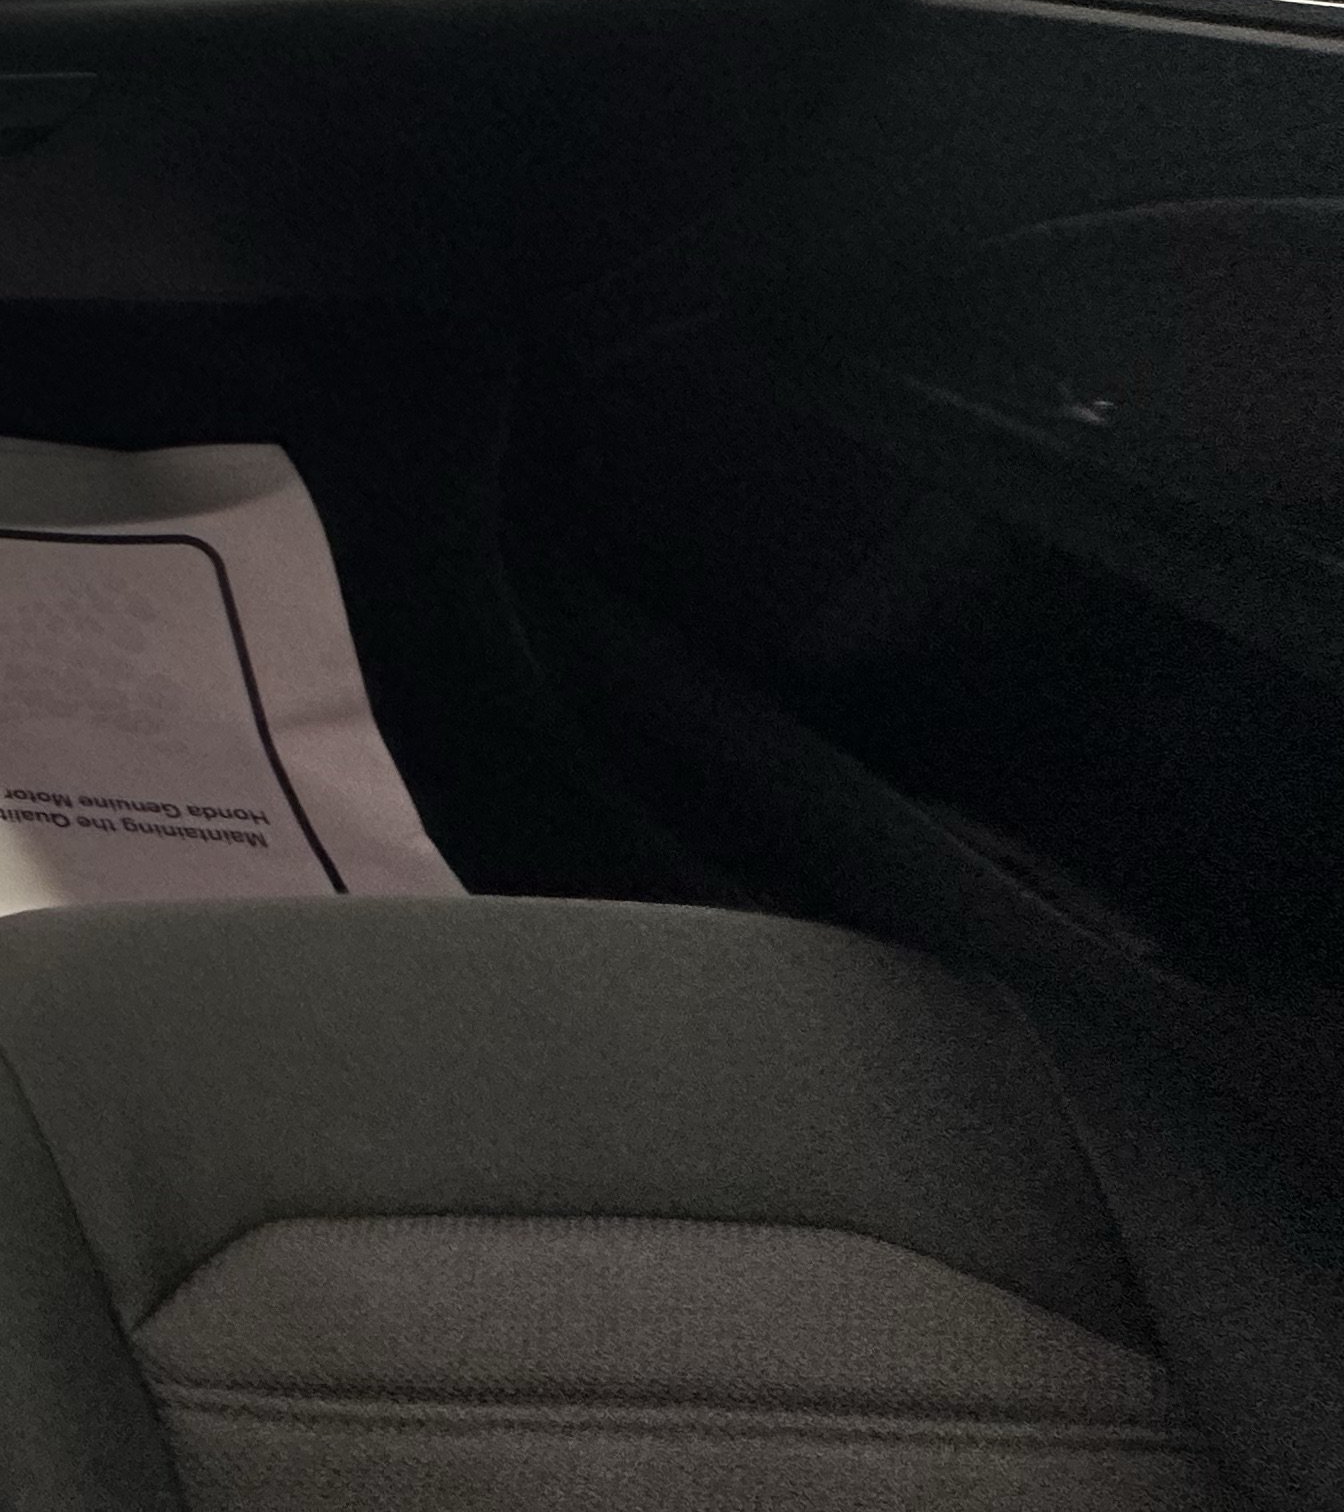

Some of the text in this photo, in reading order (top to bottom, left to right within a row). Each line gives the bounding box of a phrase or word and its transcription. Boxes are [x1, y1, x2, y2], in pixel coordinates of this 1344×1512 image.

[4, 788, 74, 809] Motor
[78, 794, 182, 819] Genuine
[76, 814, 117, 832] the
[186, 802, 271, 826] Honda
[121, 816, 269, 849] Maintaining
